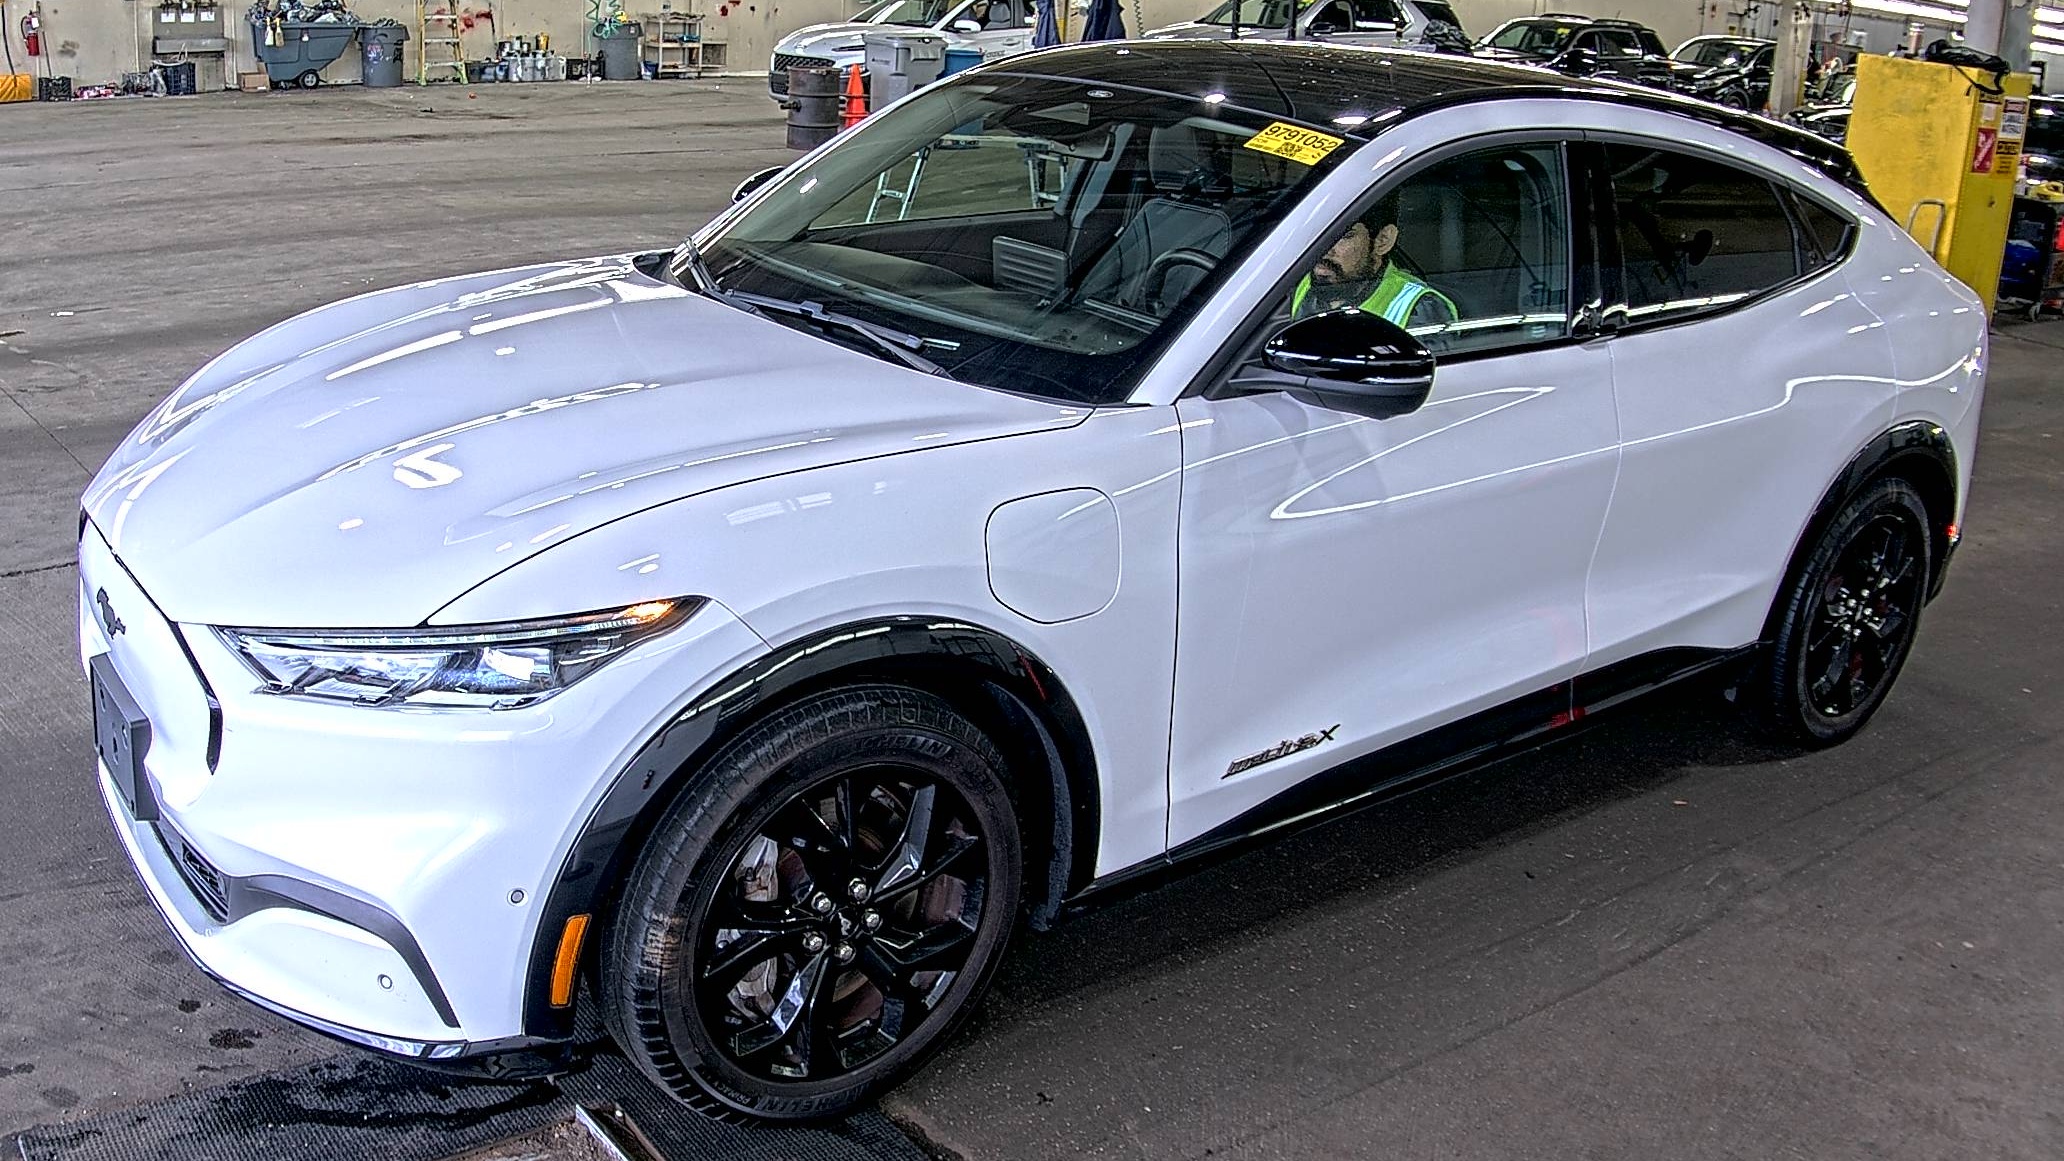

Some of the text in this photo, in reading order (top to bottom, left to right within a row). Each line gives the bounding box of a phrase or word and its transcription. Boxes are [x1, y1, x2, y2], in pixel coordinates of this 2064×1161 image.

[1264, 125, 1338, 152] 9791052
[834, 735, 945, 756] ICHELIN
[762, 1081, 870, 1113] MIHELIN
